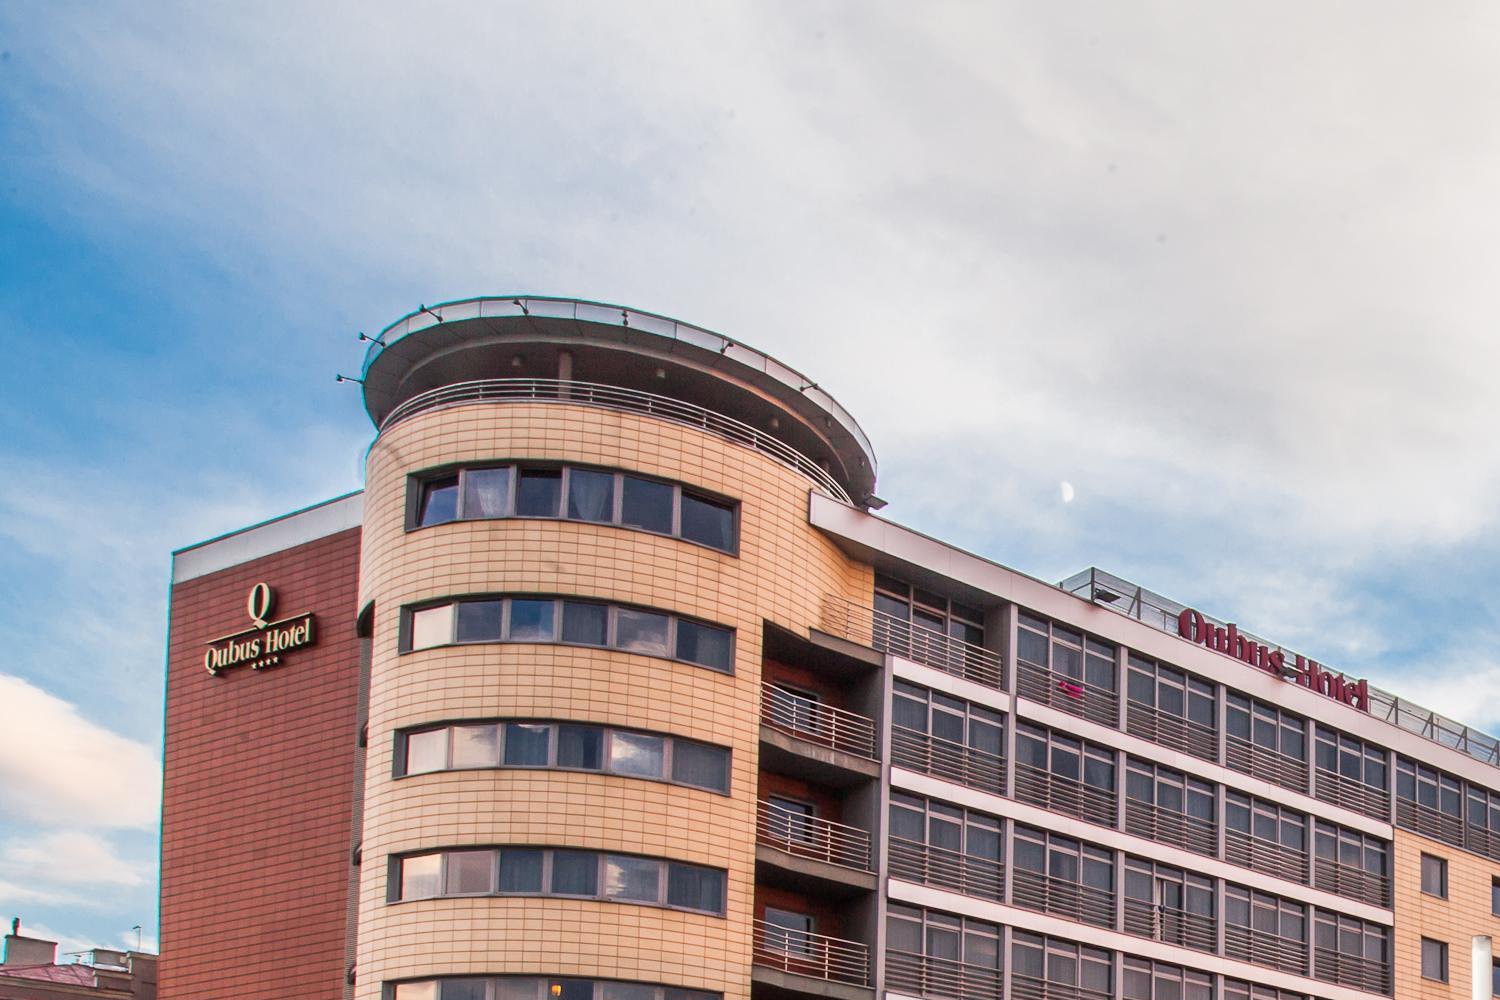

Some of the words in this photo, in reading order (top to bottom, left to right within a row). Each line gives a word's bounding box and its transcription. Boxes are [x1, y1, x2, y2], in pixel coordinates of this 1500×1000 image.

[205, 639, 261, 675] Qubus
[265, 618, 310, 653] Hotel
[1295, 654, 1369, 713] Hotel
